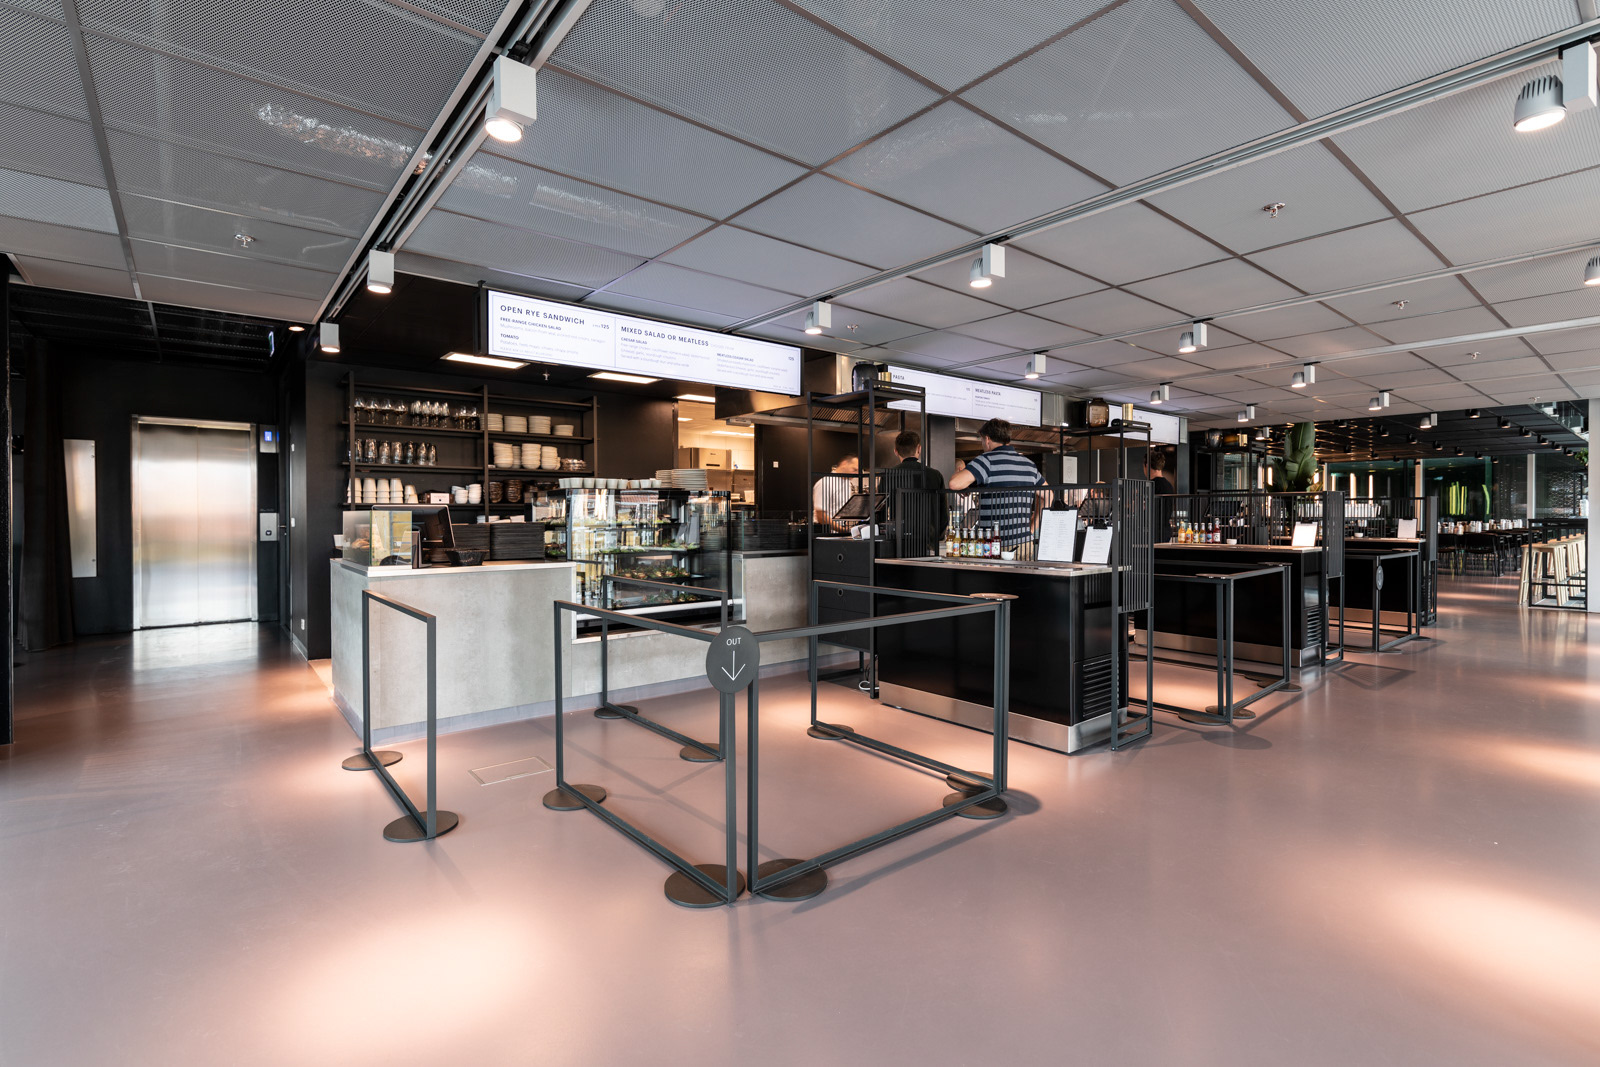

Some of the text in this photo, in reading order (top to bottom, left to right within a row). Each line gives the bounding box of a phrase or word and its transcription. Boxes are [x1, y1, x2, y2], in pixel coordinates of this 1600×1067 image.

[500, 305, 584, 325] OPEN RYE SANDWICH
[621, 326, 643, 335] MIXED
[644, 330, 666, 339] SALAD
[678, 336, 709, 346] MEATLESS
[726, 637, 742, 646] OUT
